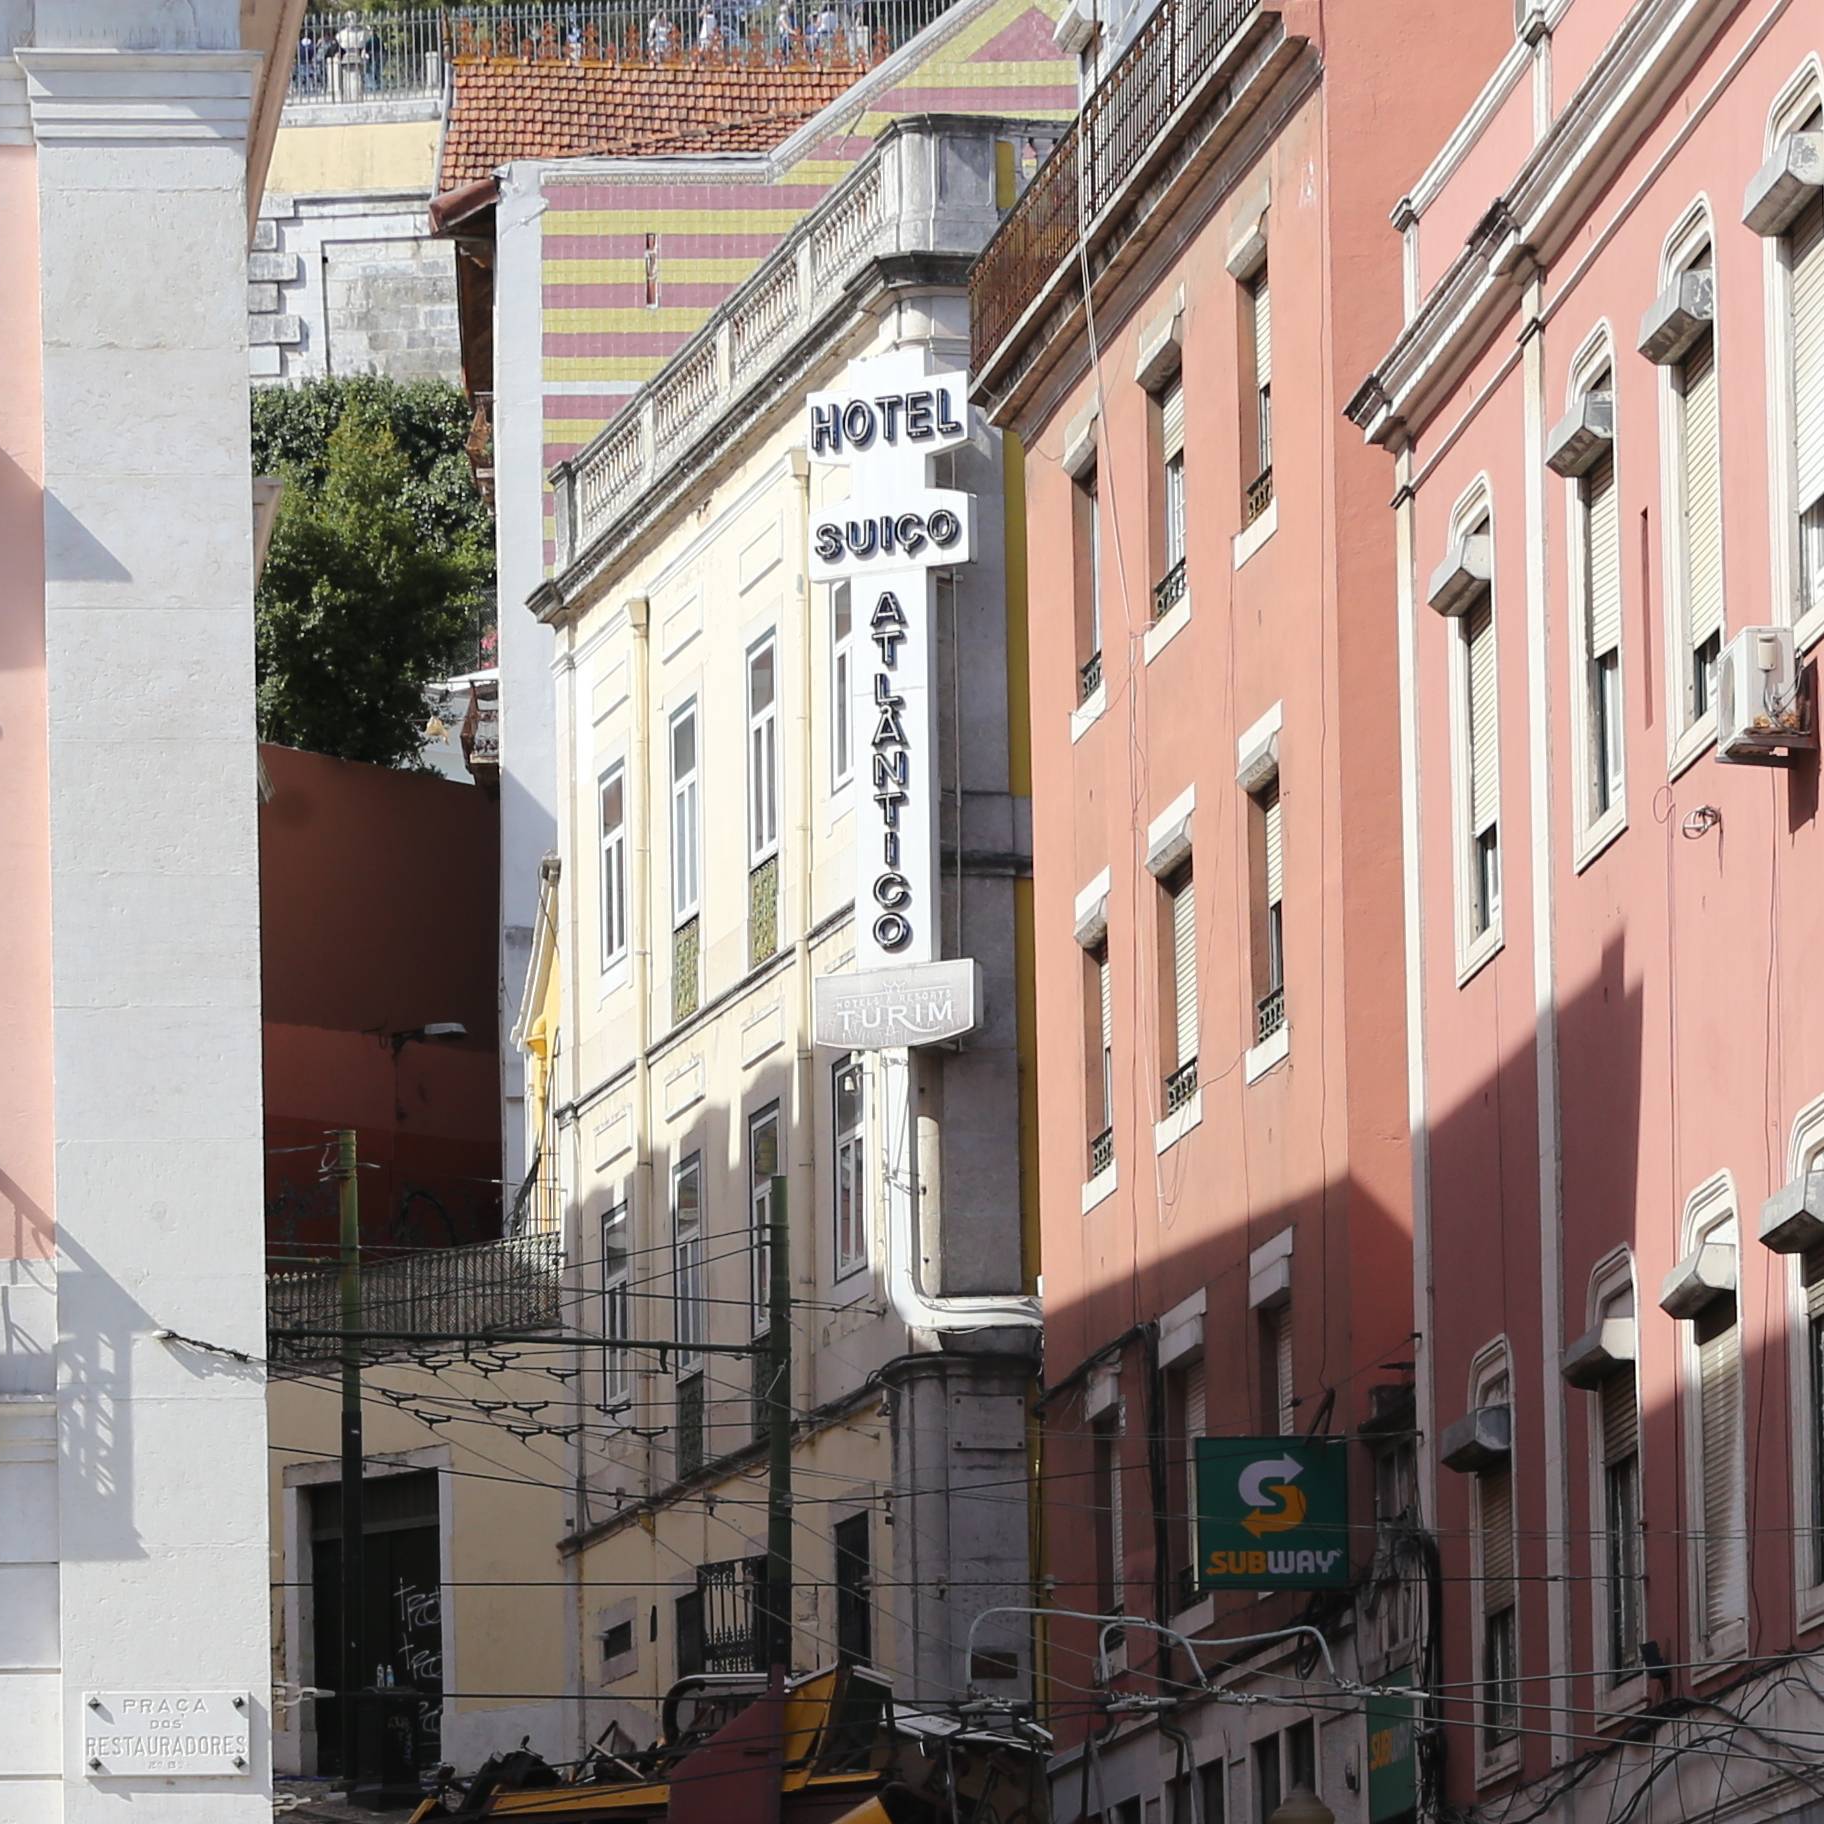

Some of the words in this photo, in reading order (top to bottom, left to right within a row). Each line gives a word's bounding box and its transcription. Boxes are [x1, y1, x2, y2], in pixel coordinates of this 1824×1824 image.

[810, 388, 964, 456] HOTEL
[814, 509, 961, 560] SUIÇO
[869, 590, 913, 952] ATLÂNTICO
[836, 1001, 954, 1033] TURIM
[1206, 1549, 1343, 1576] SUBWAY
[123, 1699, 207, 1717] PRAÇA
[150, 1720, 182, 1729] DOS
[87, 1735, 246, 1756] RESTAURADORES
